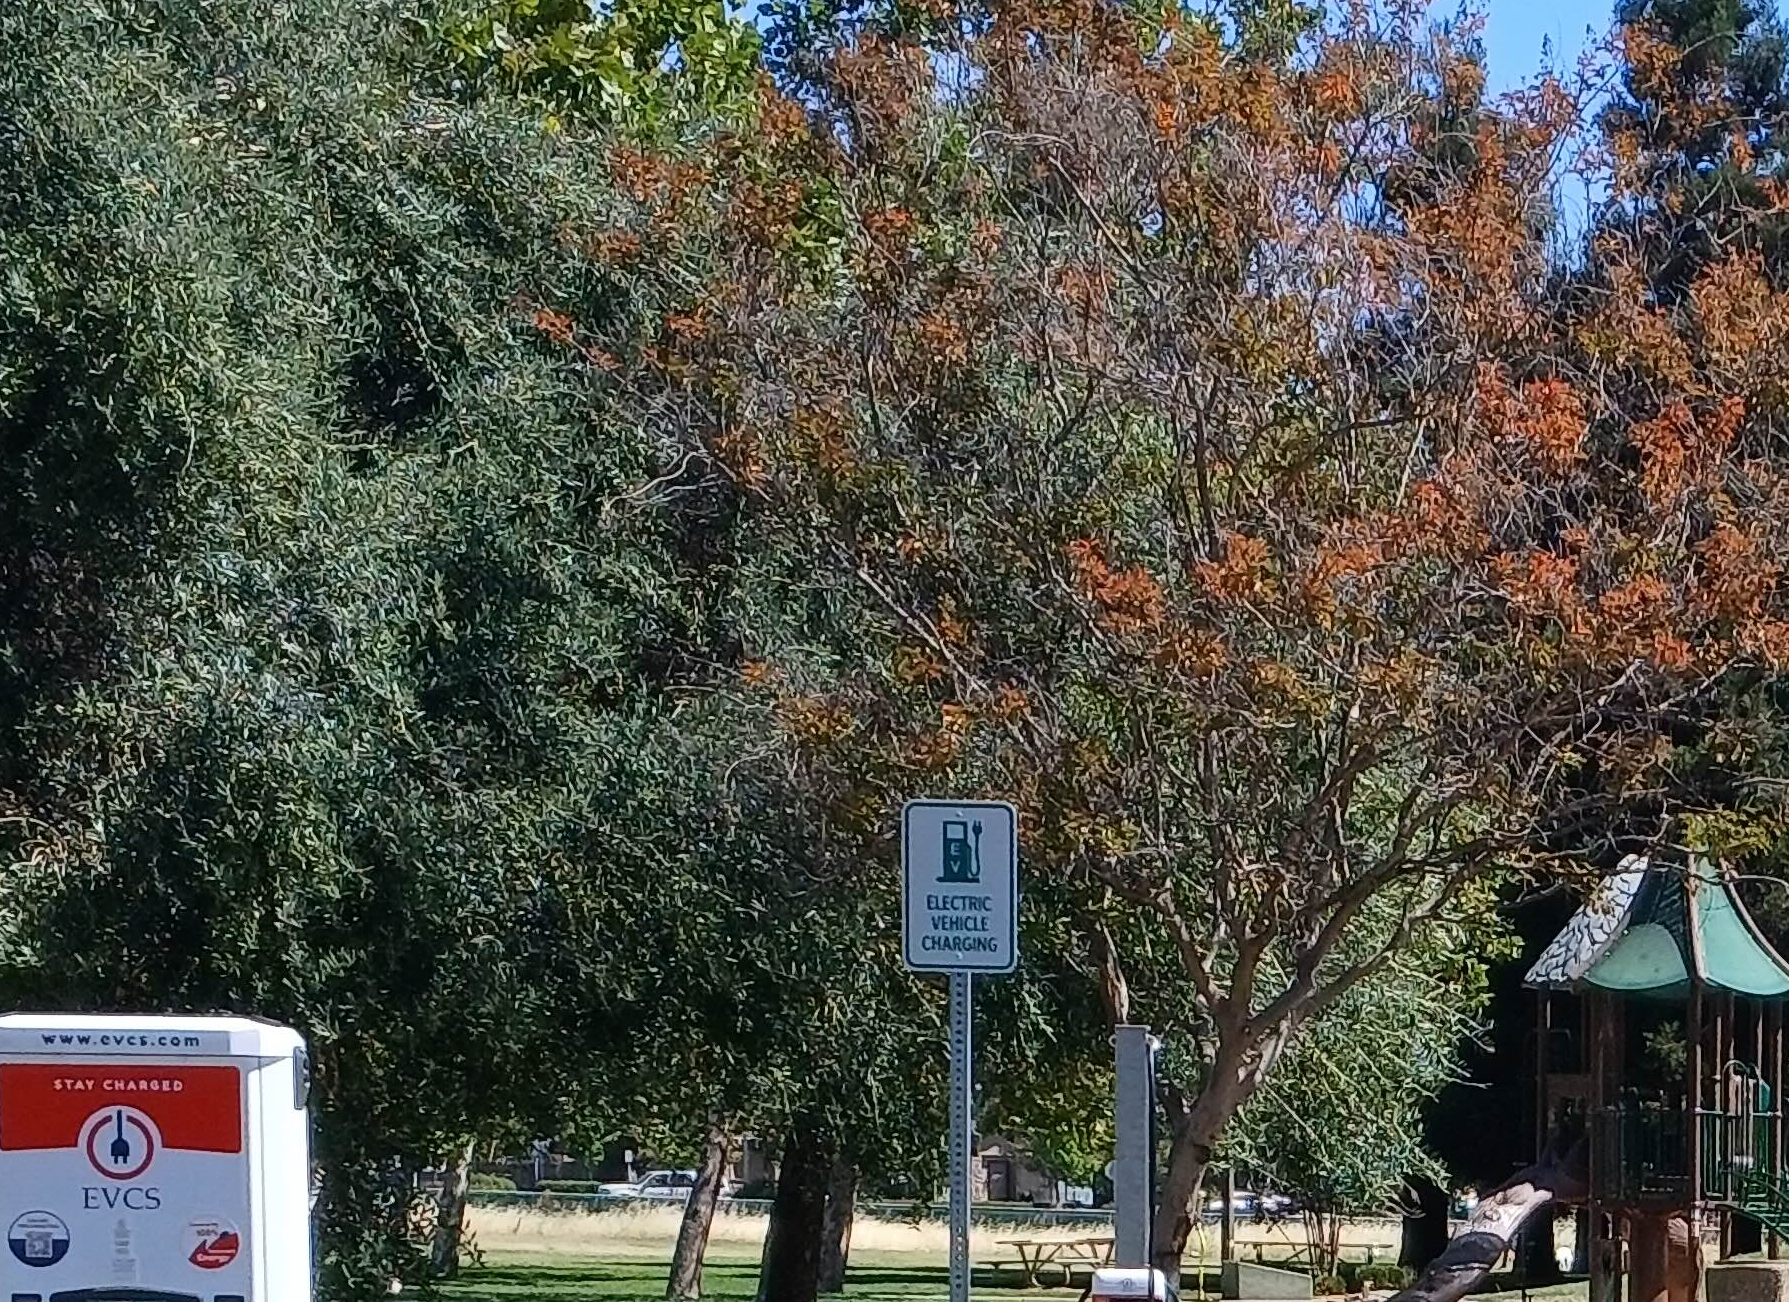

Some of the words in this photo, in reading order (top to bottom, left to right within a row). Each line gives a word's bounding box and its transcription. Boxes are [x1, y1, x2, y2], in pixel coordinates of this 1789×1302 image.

[926, 894, 993, 911] ELECTRIC
[931, 915, 989, 932] VEHICLE
[921, 936, 998, 953] CHARGING
[41, 1033, 199, 1047] www.evcs.com
[54, 1079, 95, 1090] STAY
[102, 1079, 183, 1091] CHARGED
[82, 1187, 161, 1210] EVCS
